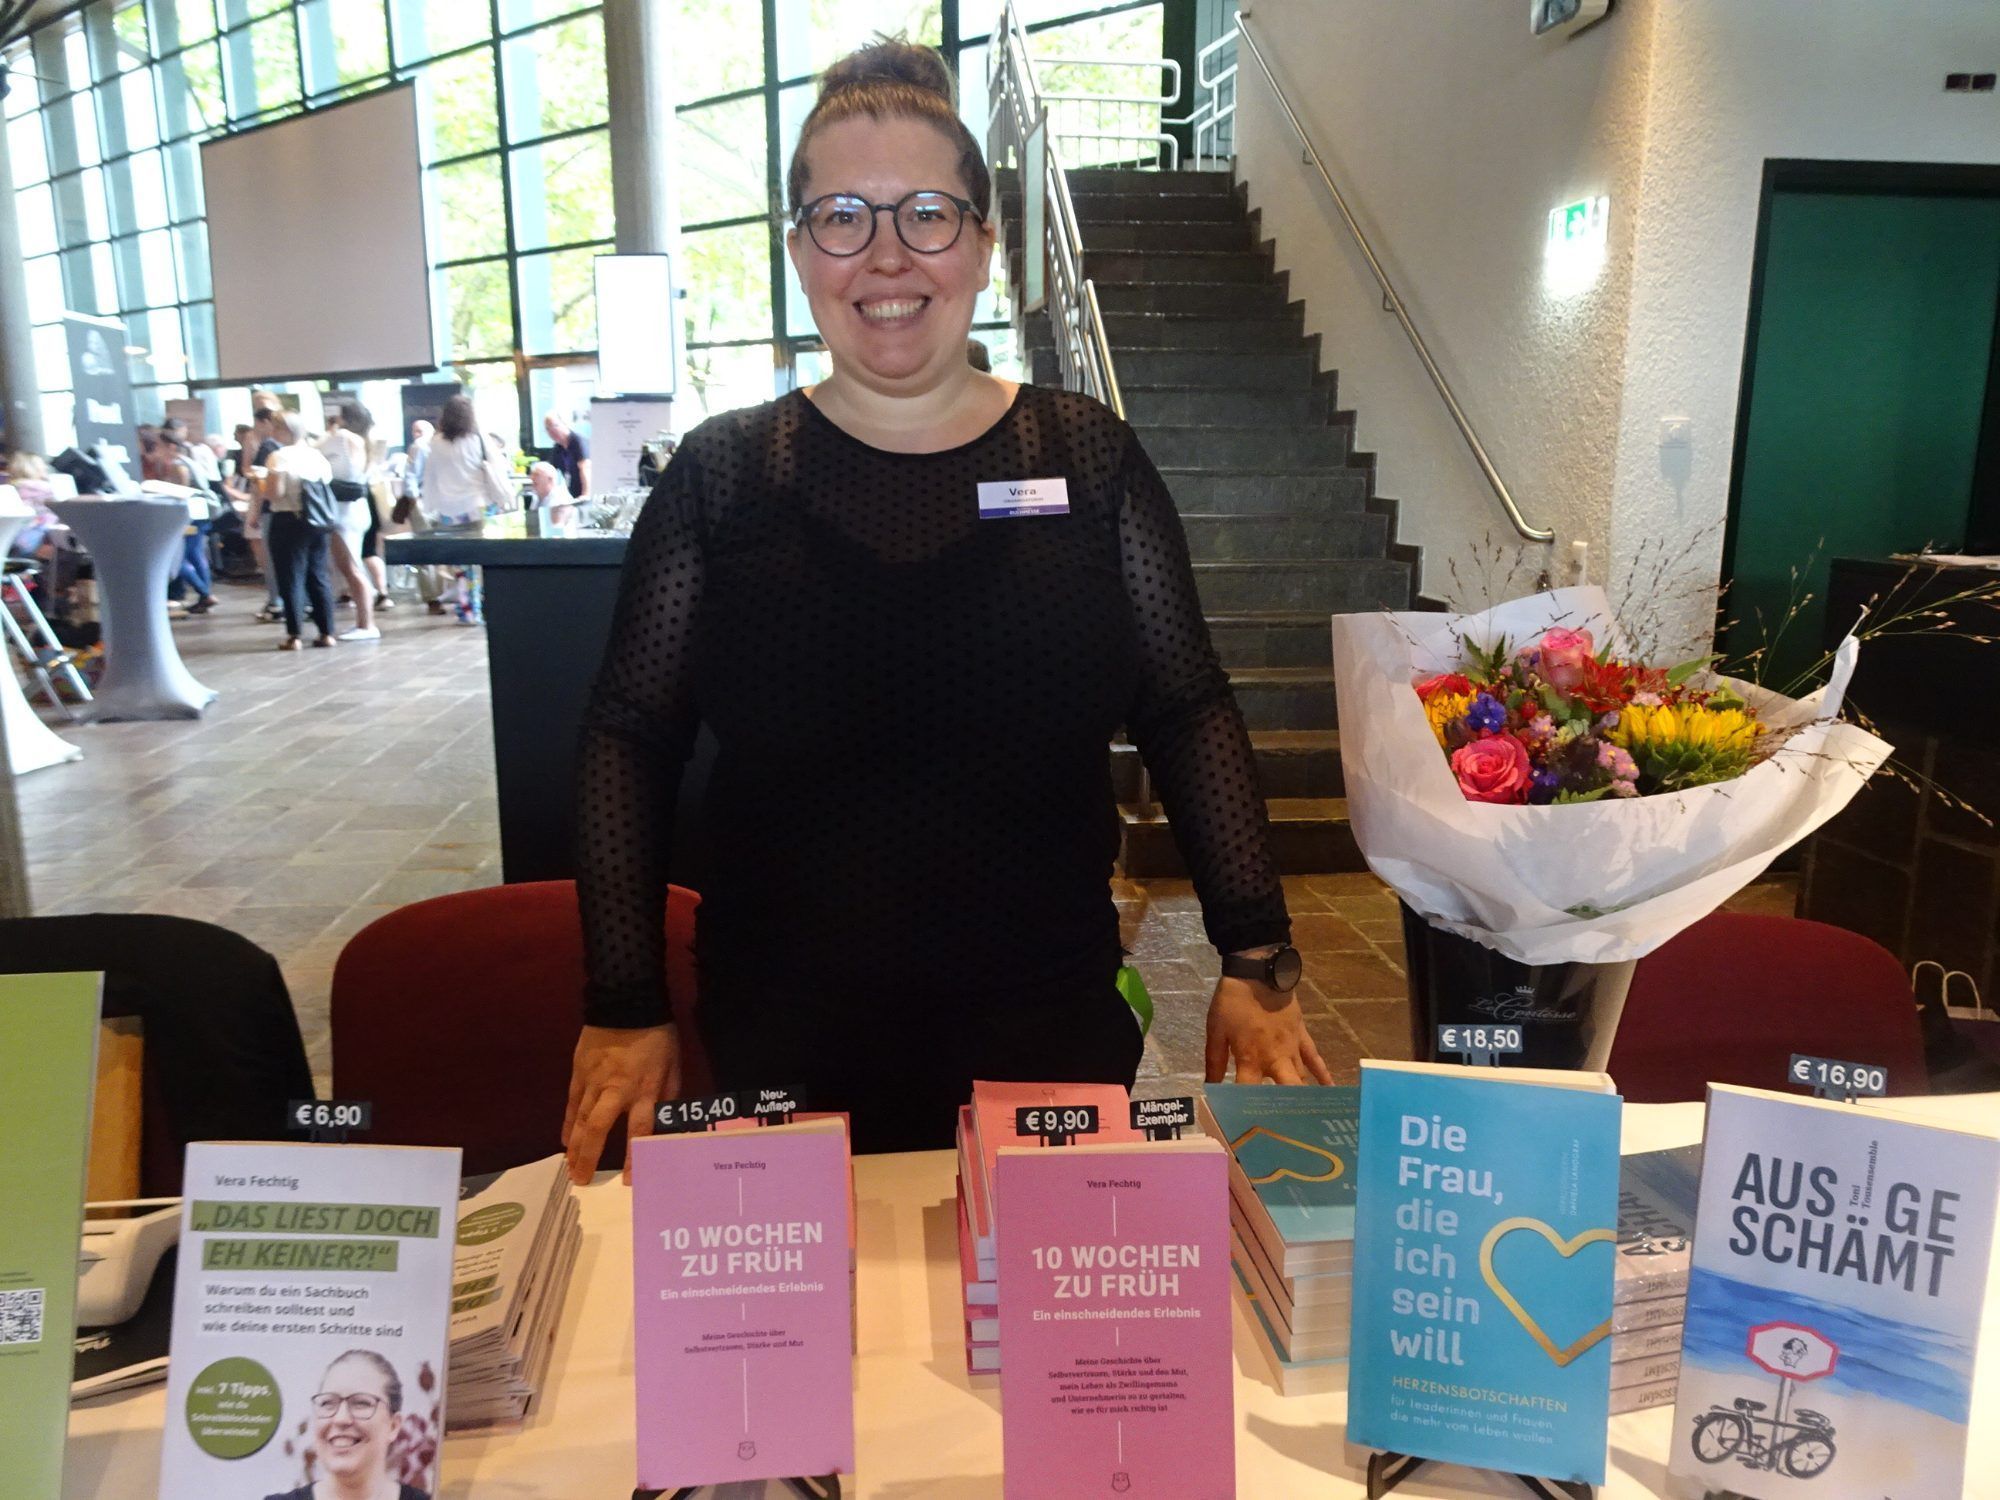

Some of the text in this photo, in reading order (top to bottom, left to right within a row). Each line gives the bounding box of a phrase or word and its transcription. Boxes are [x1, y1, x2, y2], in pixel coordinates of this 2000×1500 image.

[1009, 488, 1036, 496] Vera
[1442, 1029, 1519, 1050] € 18,50
[1793, 1060, 1884, 1091] € 16,90
[754, 1099, 796, 1114] Auflage
[760, 1090, 787, 1101] Neu-
[296, 1104, 362, 1128] € 6,90
[658, 1097, 735, 1125] € 15,40
[1139, 1100, 1185, 1115] Mängel-
[1026, 1109, 1090, 1133] € 9,90
[1137, 1112, 1189, 1128] Exemplar
[1400, 1115, 1467, 1153] Die
[714, 1161, 766, 1171] Vera Fechtig
[215, 1175, 299, 1190] Vera Fechtig
[1087, 1179, 1141, 1190] Vera Fechtig
[1399, 1155, 1503, 1206] Frau,
[1731, 1152, 1961, 1244] AUS GE
[1849, 1184, 1861, 1207] Toni
[193, 1204, 268, 1231] „DAS
[274, 1205, 350, 1231] LIEST
[355, 1207, 434, 1234] DOCH
[1395, 1198, 1459, 1236] die
[659, 1221, 823, 1250] 10 WOCHEN
[207, 1242, 248, 1267] EH
[681, 1246, 803, 1277] ZU FRÜH
[1031, 1244, 1200, 1270] 10 WOCHEN
[1394, 1237, 1456, 1279] ich
[1729, 1205, 1955, 1298] SCHÄMT
[205, 1284, 369, 1299] Warum du ein Sachbuch
[660, 1281, 824, 1300] Ein einschneidendes Erlebnis
[1053, 1269, 1179, 1298] ZU FRÜH
[204, 1302, 355, 1317] schreiben solltest und
[1033, 1307, 1201, 1321] Ein einschneidendes Erlebnis
[1392, 1287, 1480, 1325] sein
[203, 1320, 403, 1337] wie deine ersten Schritte sind
[772, 1340, 787, 1349] und
[1390, 1327, 1464, 1366] will
[1075, 1356, 1161, 1366] Meine Geschichte über
[1138, 1367, 1154, 1376] und
[1155, 1367, 1169, 1376] den
[1171, 1367, 1189, 1377] Mut,
[218, 1382, 228, 1395] 7
[1060, 1382, 1079, 1391] mein
[1081, 1381, 1104, 1390] Leben
[1106, 1381, 1117, 1389] als
[1392, 1375, 1568, 1413] HERZENSBOTSCHAFTEN
[1051, 1394, 1066, 1403] und
[1109, 1404, 1129, 1413] mich
[1391, 1393, 1405, 1406] für
[1486, 1411, 1508, 1424] und
[1390, 1409, 1553, 1445] die mehr vom Leben wollen
